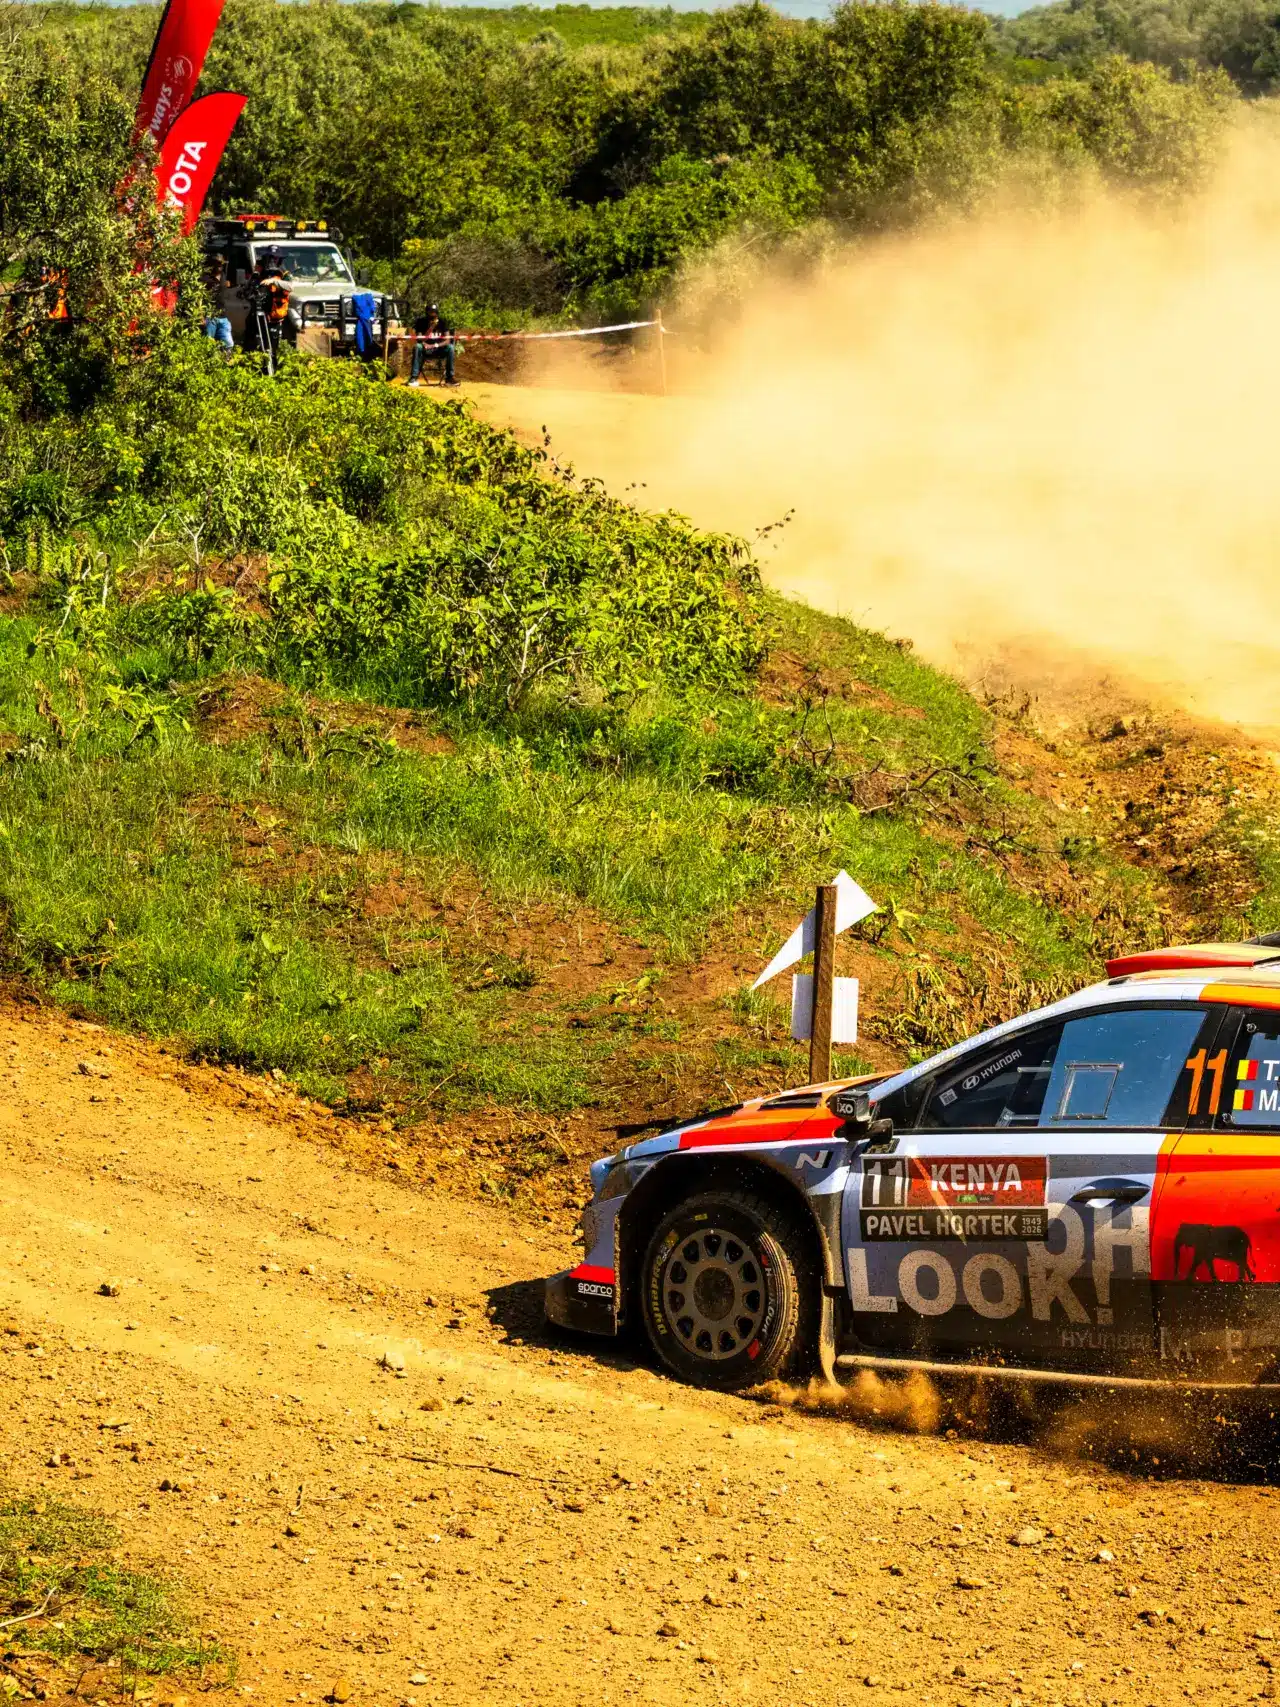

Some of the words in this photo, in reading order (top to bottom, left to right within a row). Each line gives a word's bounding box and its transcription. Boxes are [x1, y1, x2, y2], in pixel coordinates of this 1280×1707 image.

[981, 1049, 1022, 1079] HYUNDAI
[1186, 1048, 1228, 1115] 11
[867, 1161, 903, 1205] 11
[930, 1163, 1022, 1191] KENYA
[866, 1214, 931, 1236] PAVEL
[936, 1214, 1018, 1236] HORTEK
[1022, 1217, 1042, 1225] 1949
[1022, 1225, 1042, 1234] 2026
[577, 1282, 613, 1298] sparco
